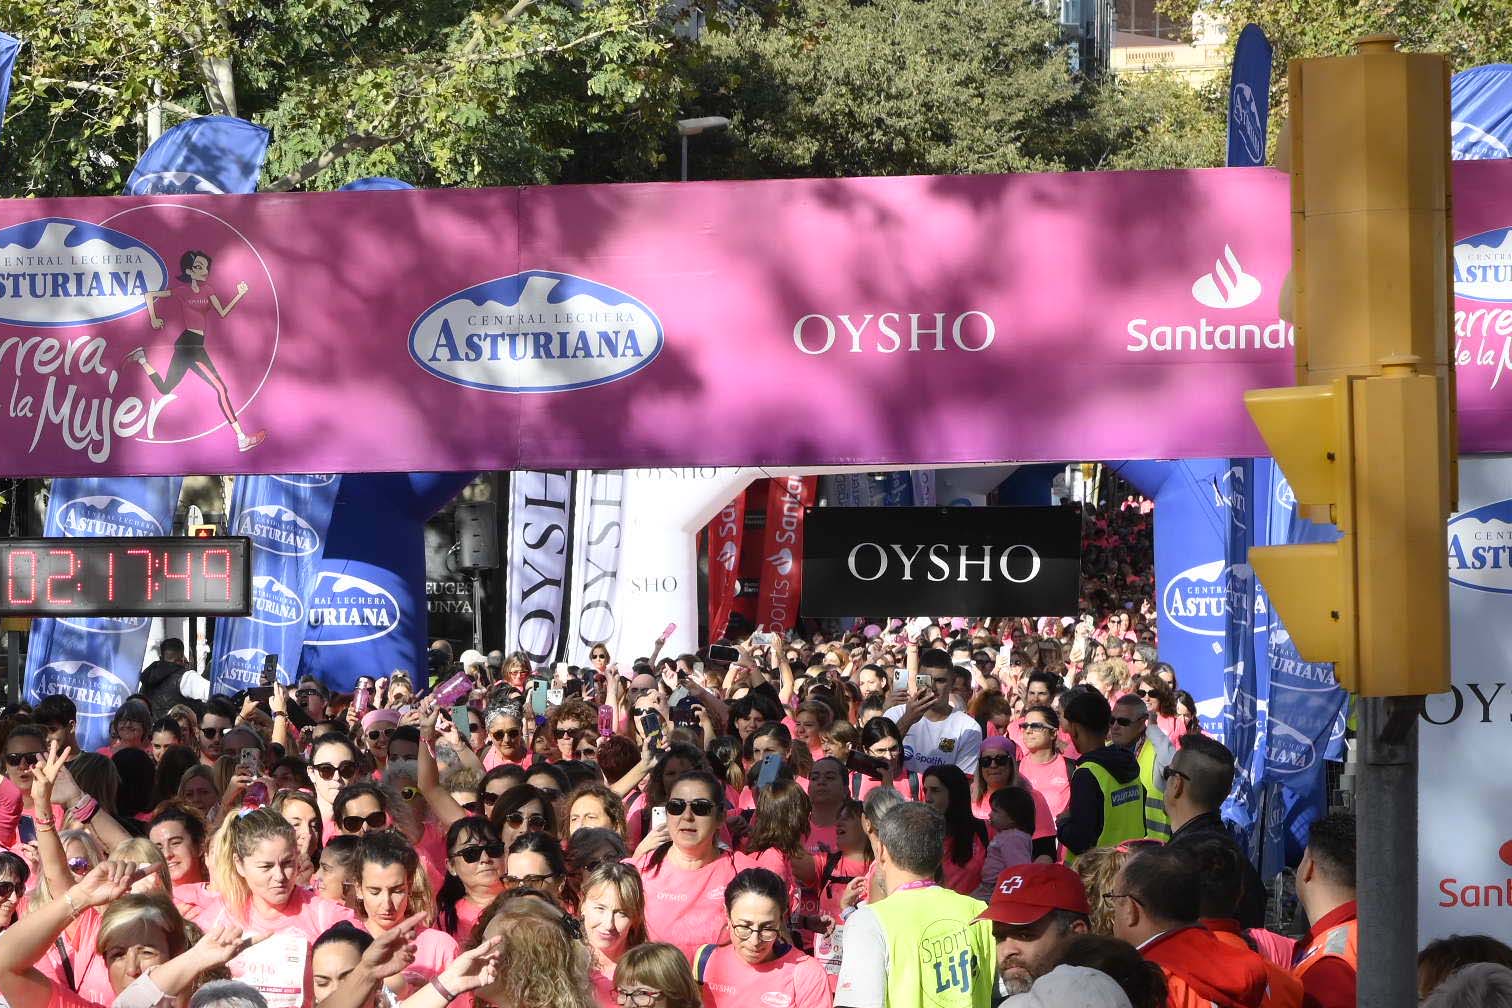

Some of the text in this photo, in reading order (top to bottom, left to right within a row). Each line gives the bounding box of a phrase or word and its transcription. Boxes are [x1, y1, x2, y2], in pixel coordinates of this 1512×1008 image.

[70, 254, 144, 266] LECHERA
[467, 312, 636, 327] CENTRAL LECHERA
[793, 310, 996, 355] OYSHO
[1126, 318, 1295, 352] Santand
[428, 318, 643, 363] ASTURIANA
[1476, 340, 1495, 366] la
[9, 378, 33, 418] la
[29, 369, 179, 464] Mujer
[240, 517, 311, 550] ASTURIANA
[7, 549, 232, 604] 02:17:49
[847, 542, 1042, 583] OYSHO
[309, 608, 391, 627] URIANA
[338, 597, 386, 605] LECHERA
[38, 674, 122, 707] ASTURIANA
[921, 926, 971, 964] Sport
